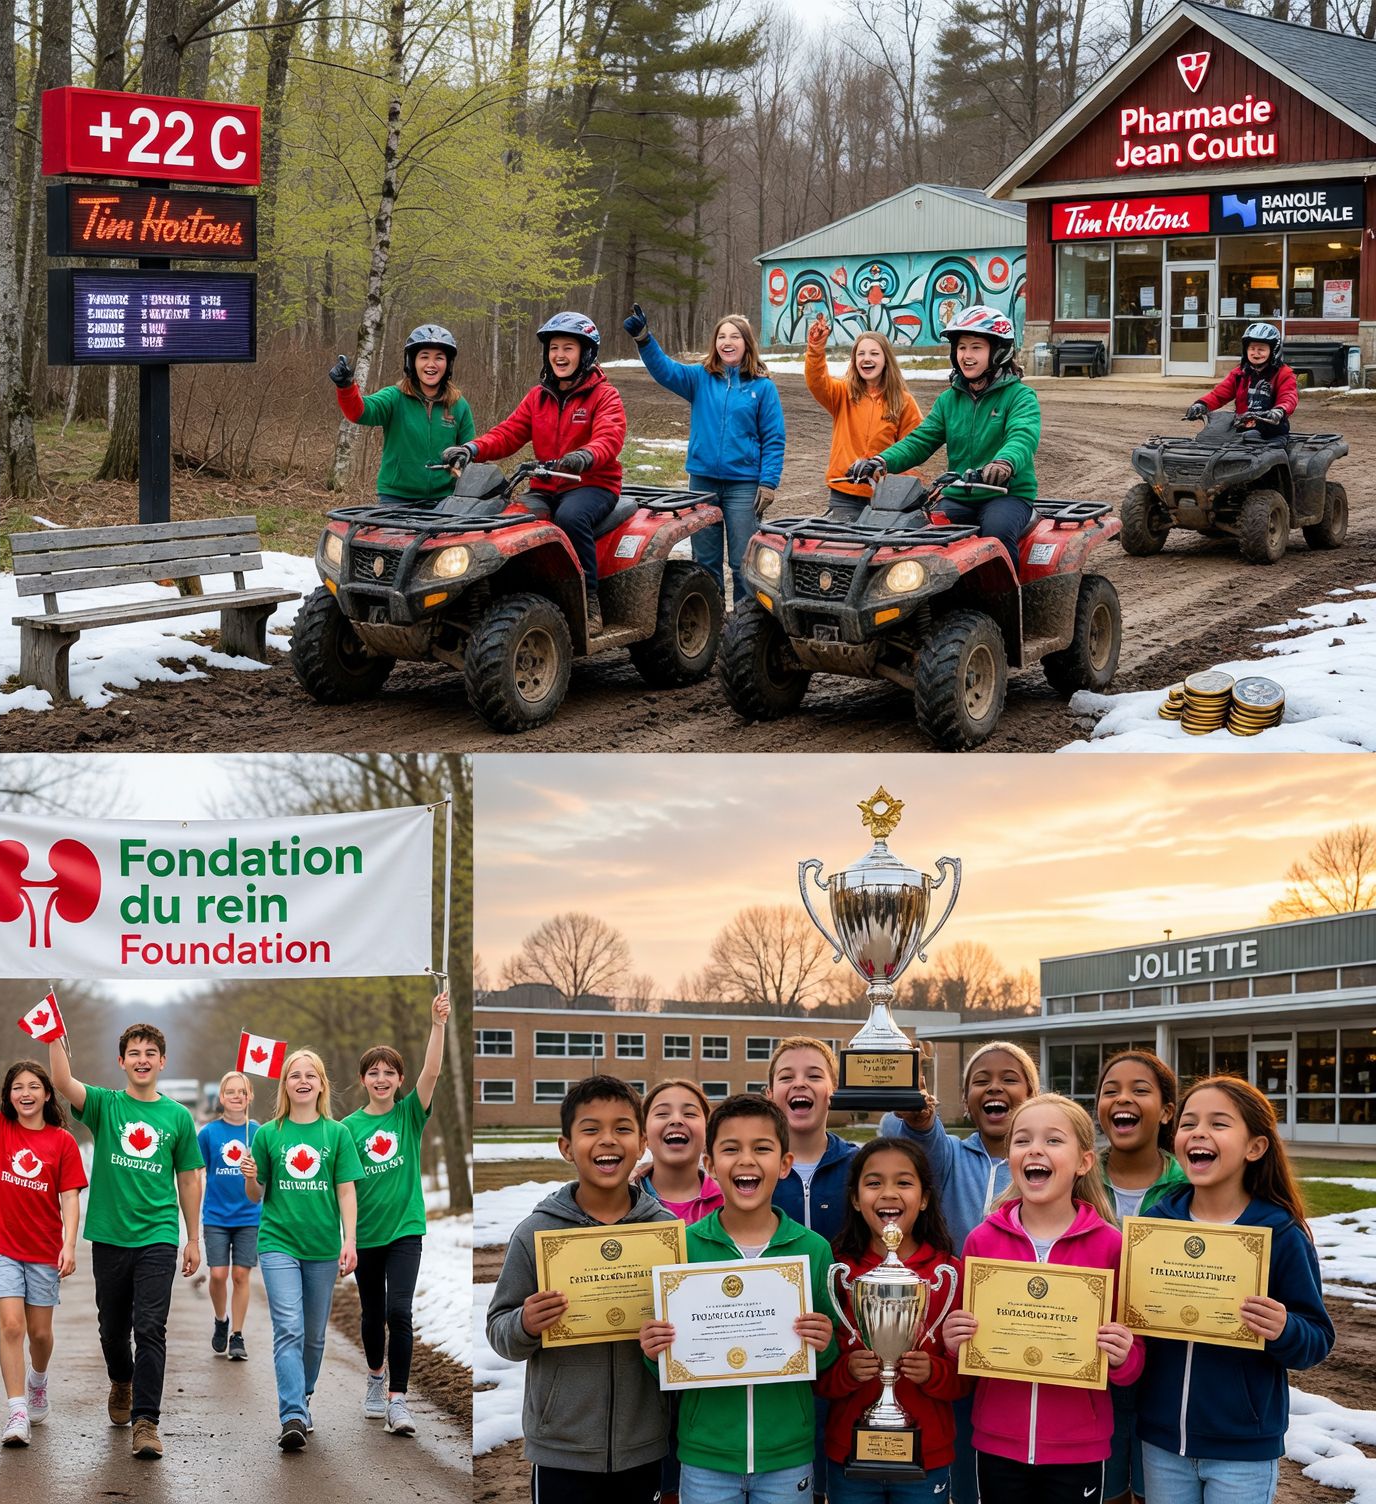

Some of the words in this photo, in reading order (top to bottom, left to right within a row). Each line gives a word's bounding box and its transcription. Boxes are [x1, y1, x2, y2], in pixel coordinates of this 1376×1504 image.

[1120, 95, 1272, 136] Pharmacie
[89, 107, 195, 167] +22
[210, 116, 247, 170] C
[1115, 141, 1180, 168] Jean
[1187, 130, 1276, 162] Coutu
[1064, 205, 1102, 236] Tim
[1105, 203, 1191, 233] Hortons
[1262, 191, 1327, 209] BANQUE
[1262, 207, 1354, 225] NATIONALE
[78, 197, 133, 241] Tim
[139, 196, 244, 246] Hortons
[119, 835, 364, 877] Fondation
[119, 884, 180, 924] du
[197, 883, 288, 923] rein
[121, 932, 331, 966] Foundation
[1128, 939, 1258, 982] JOLIETTE
